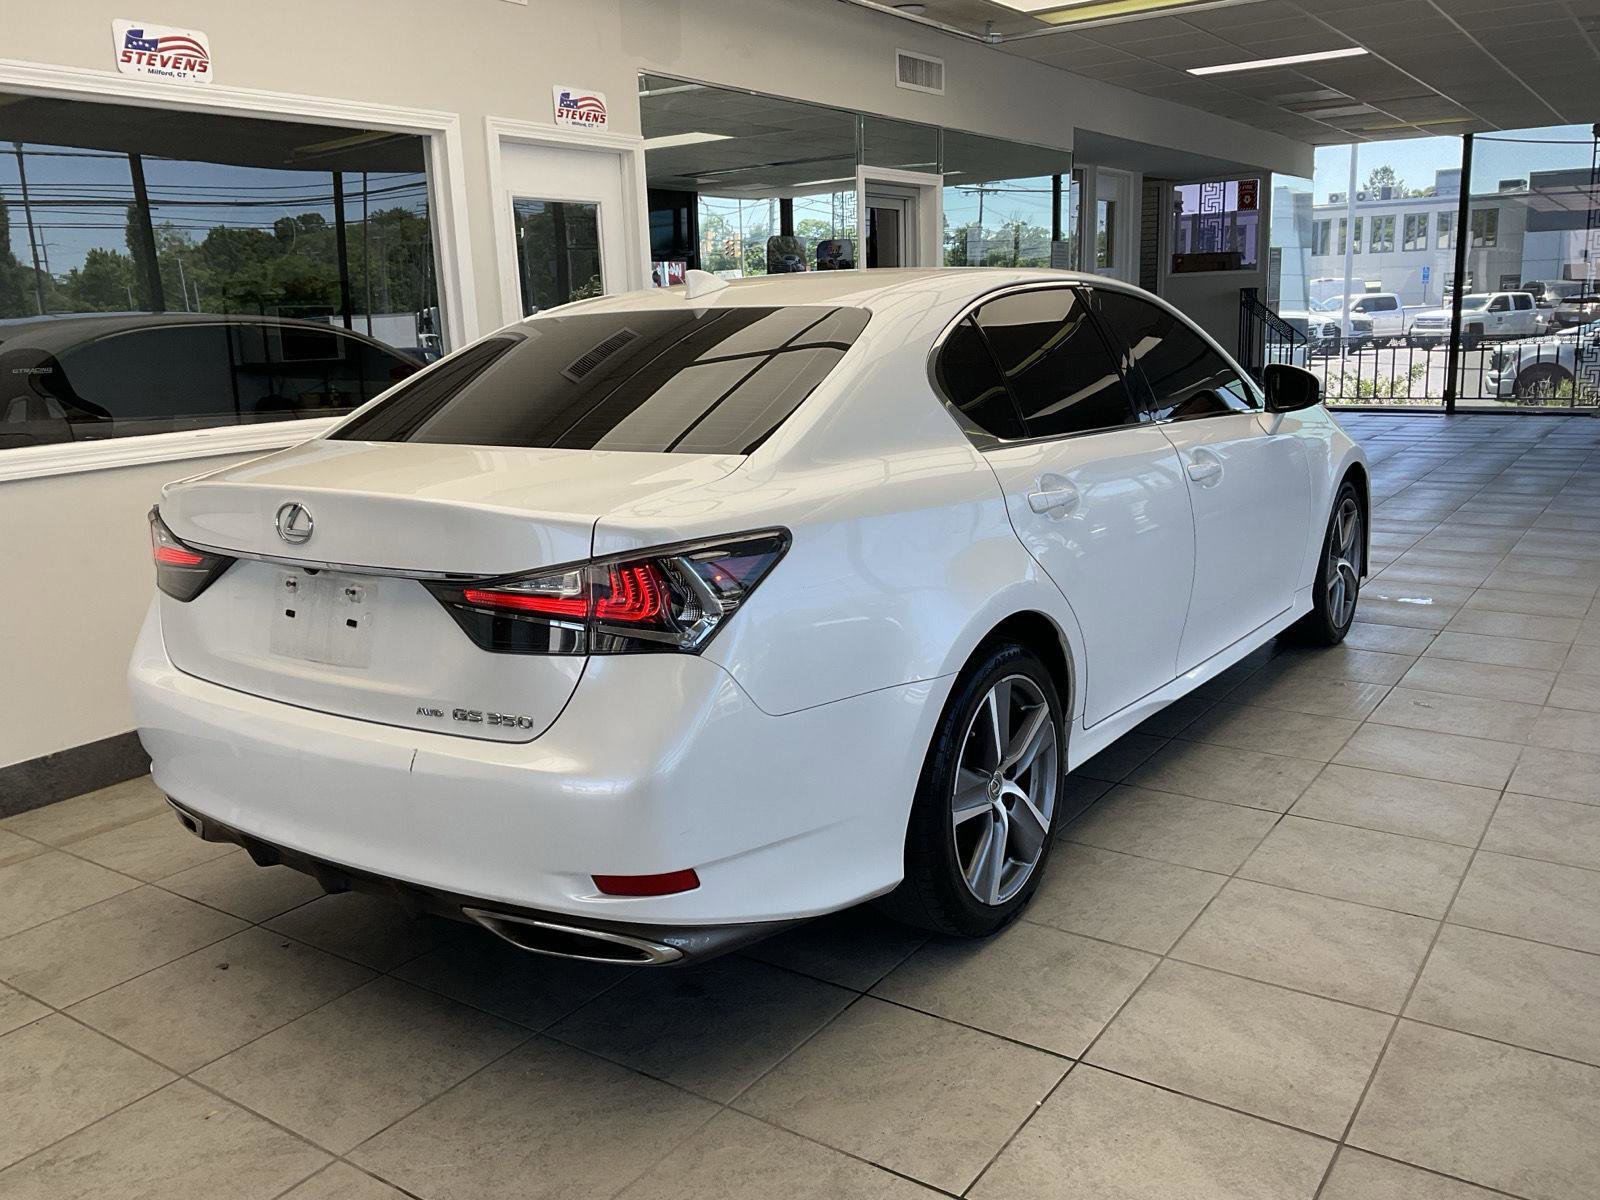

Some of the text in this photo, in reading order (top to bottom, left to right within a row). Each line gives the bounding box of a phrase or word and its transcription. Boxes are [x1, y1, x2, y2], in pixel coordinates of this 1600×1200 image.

[120, 50, 209, 73] STEVENS
[147, 68, 175, 78] Milford,
[557, 108, 607, 124] STEVENS
[416, 706, 534, 729] AWD GS 350
